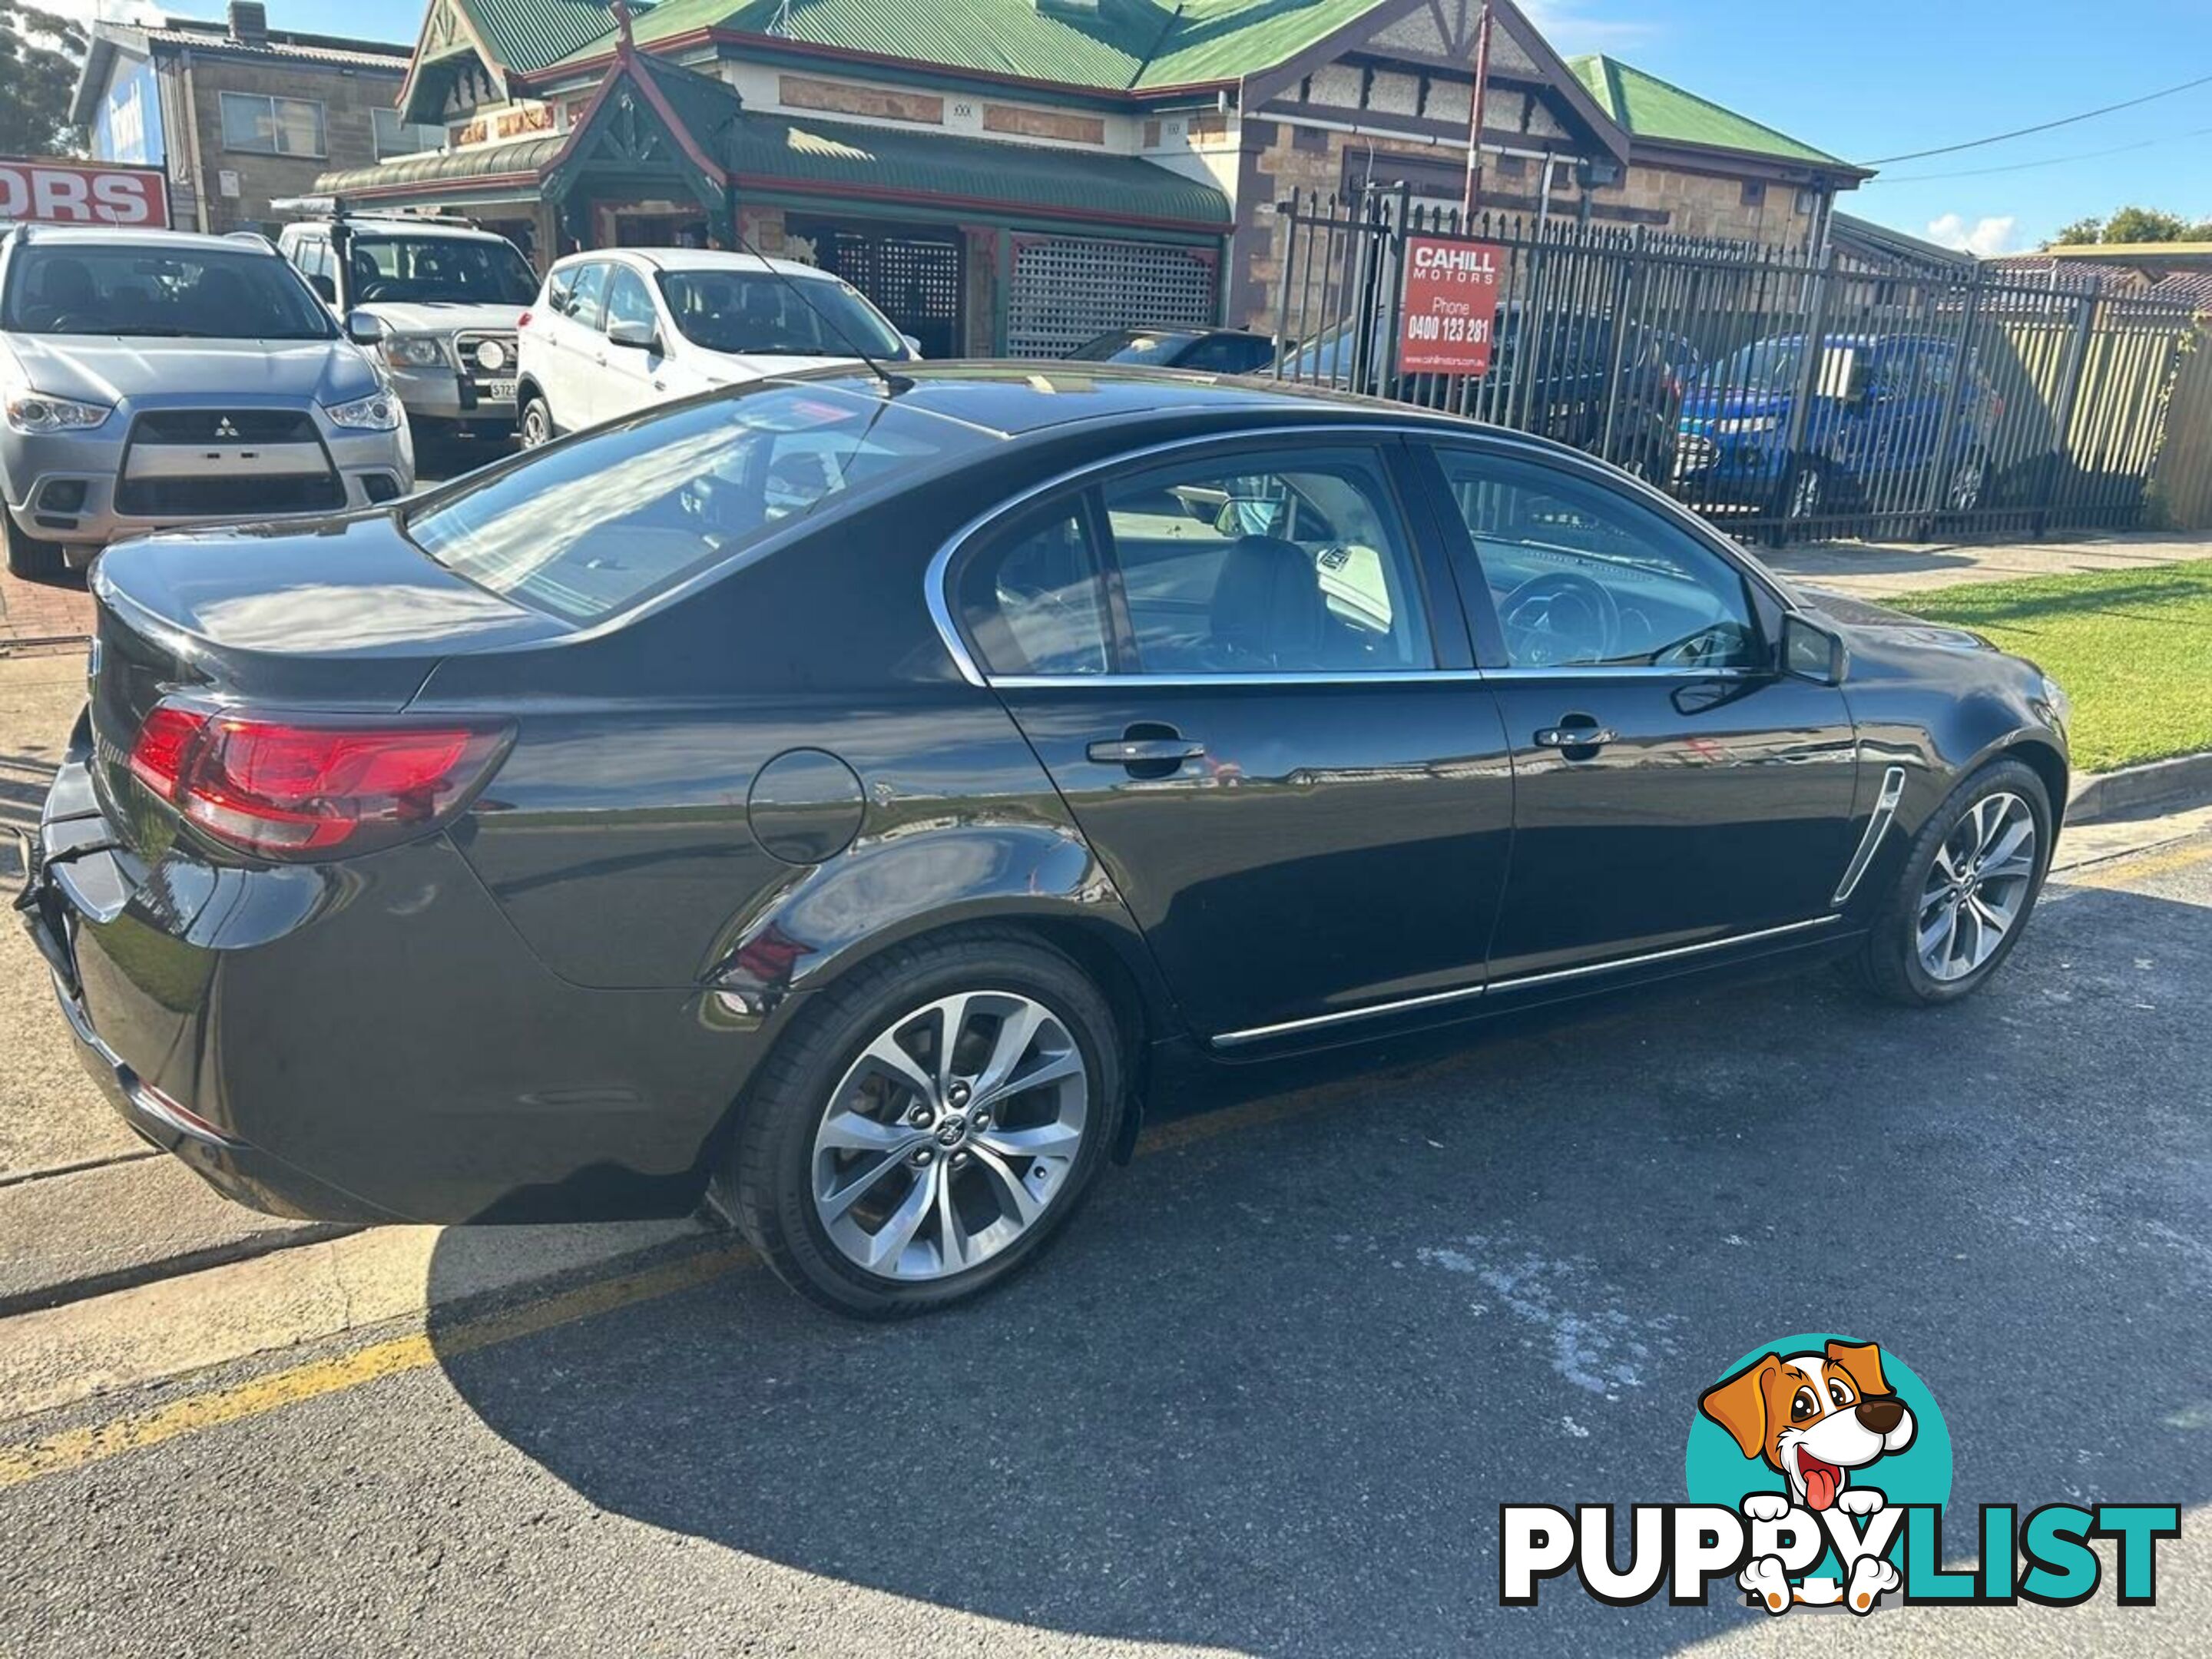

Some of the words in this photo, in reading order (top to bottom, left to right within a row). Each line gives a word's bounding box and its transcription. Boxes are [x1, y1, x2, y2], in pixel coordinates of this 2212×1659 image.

[1415, 247, 1495, 273] CAHILL
[1413, 268, 1494, 285] MOTORS
[1432, 296, 1470, 314] Phone
[1408, 315, 1439, 340] 0400
[1442, 317, 1465, 343] 123
[1466, 319, 1489, 343] 281
